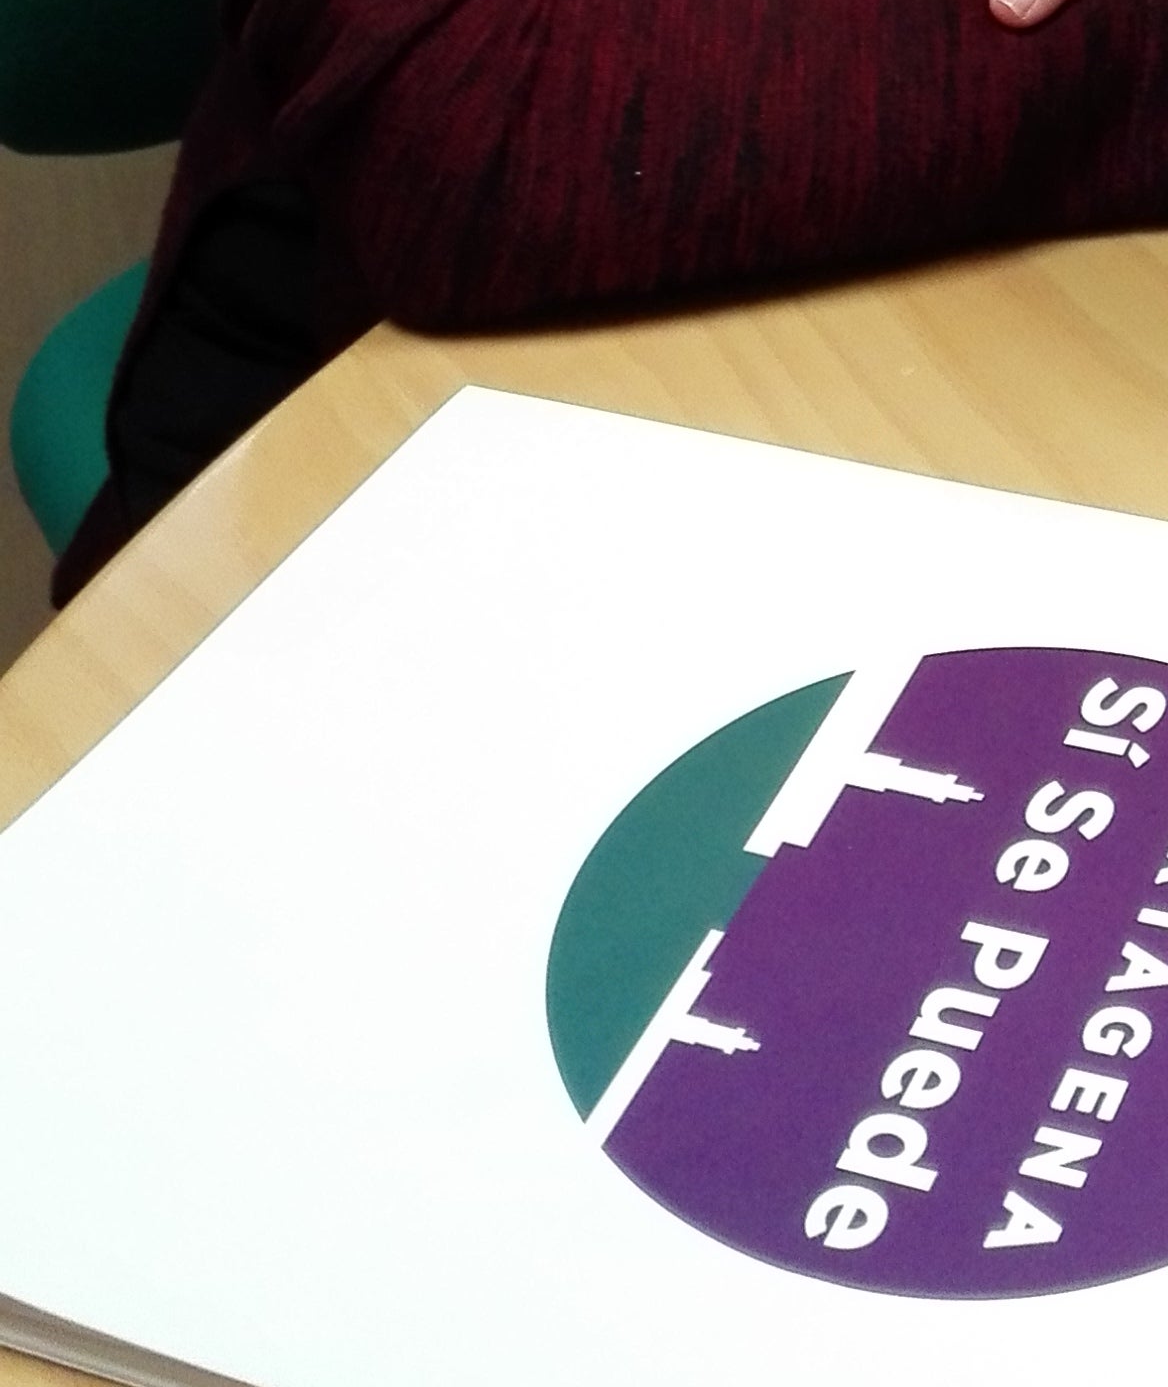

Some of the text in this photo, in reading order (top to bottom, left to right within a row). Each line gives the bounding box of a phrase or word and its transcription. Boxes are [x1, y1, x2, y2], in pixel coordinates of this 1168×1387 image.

[803, 675, 1168, 1252] Sí Se Puede
